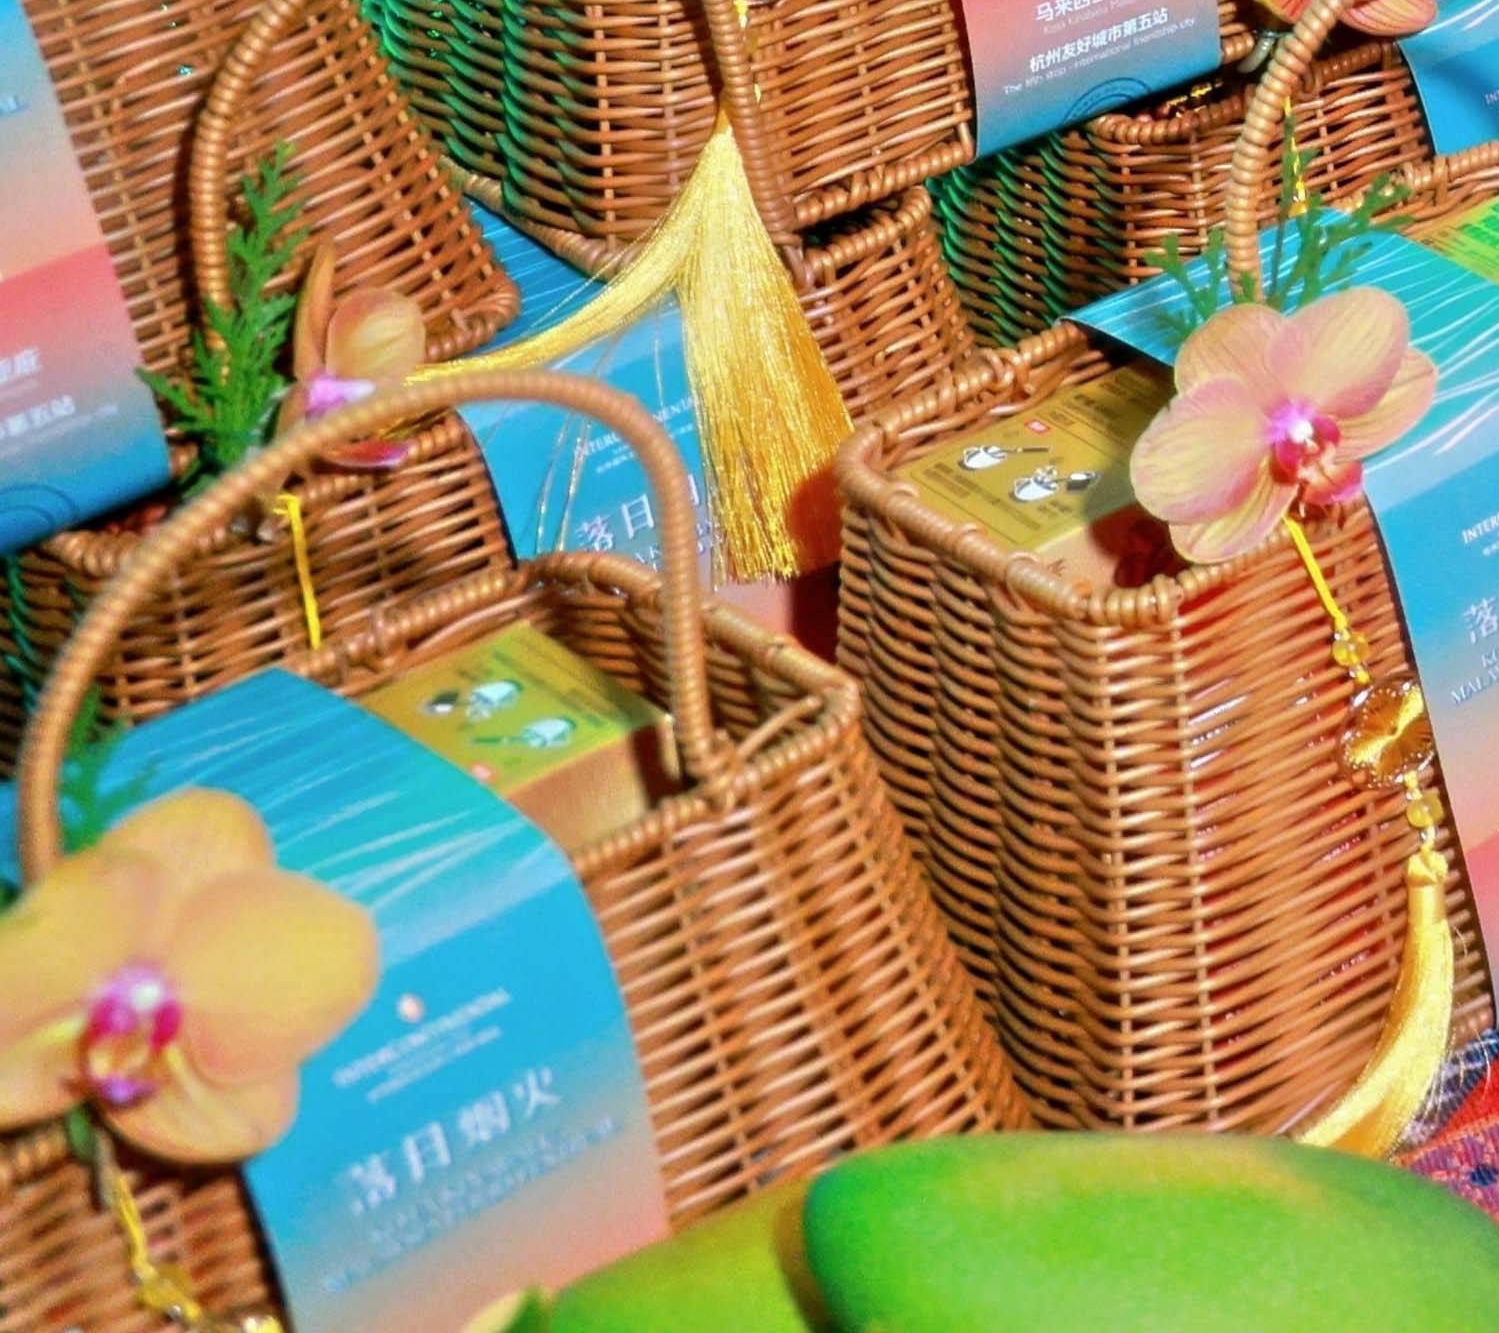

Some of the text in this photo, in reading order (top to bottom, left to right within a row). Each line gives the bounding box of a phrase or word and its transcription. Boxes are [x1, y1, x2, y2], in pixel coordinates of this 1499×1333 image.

[1030, 7, 1169, 73] 杭州友好城市第五站
